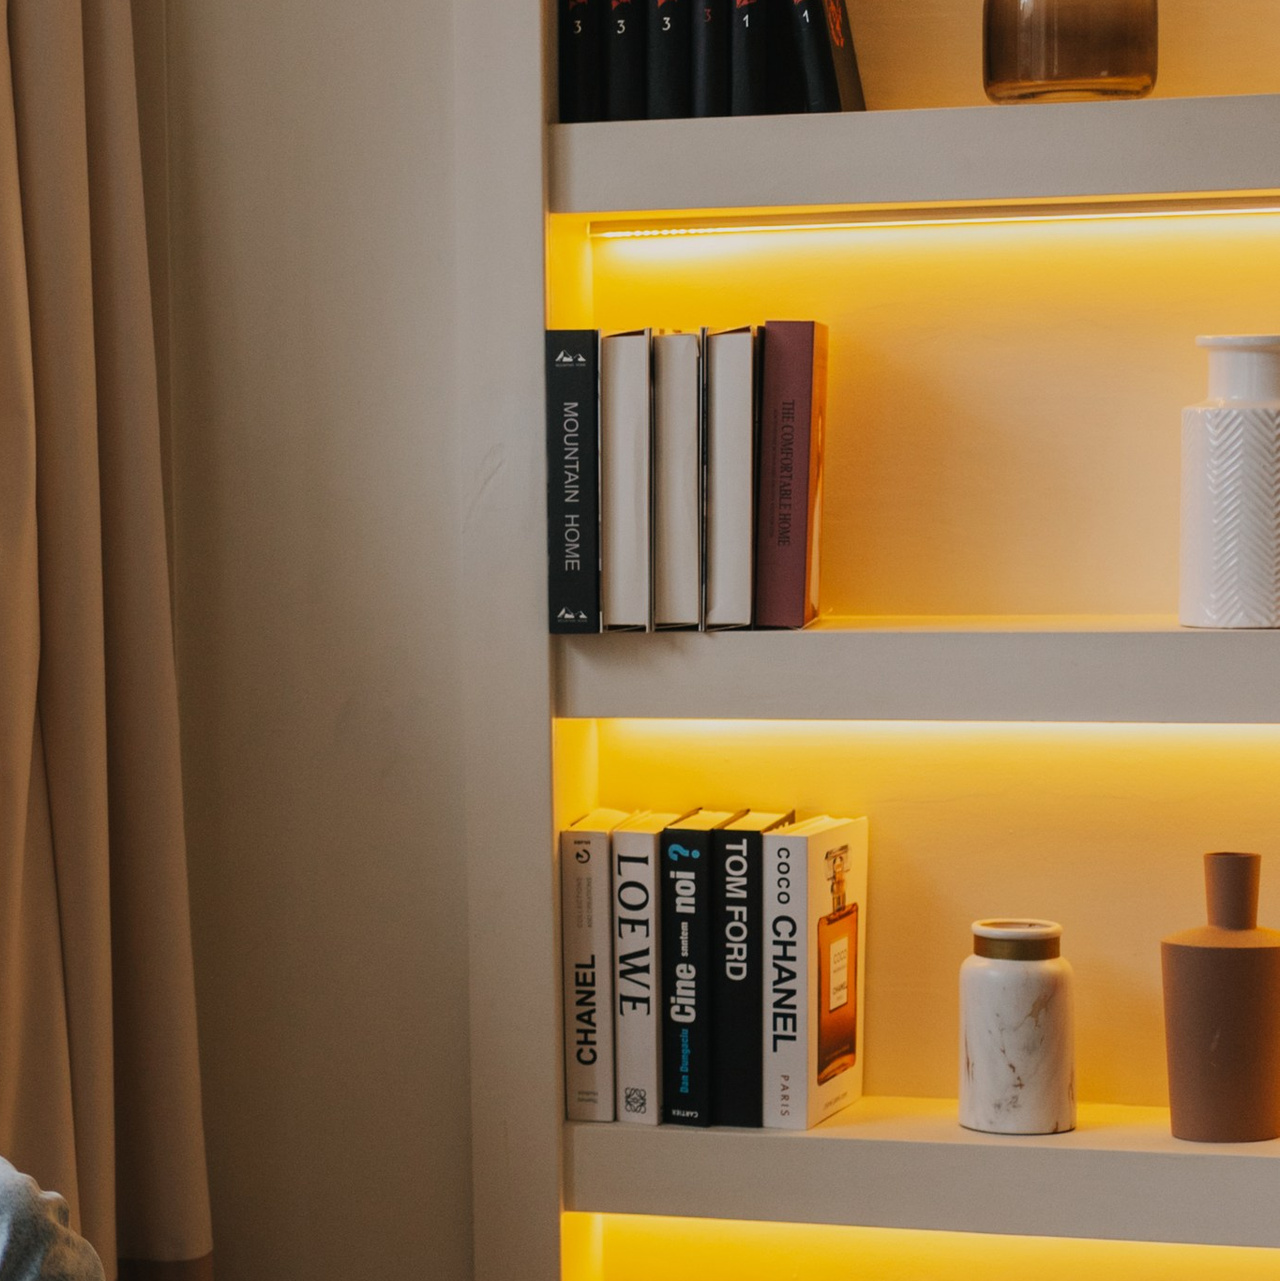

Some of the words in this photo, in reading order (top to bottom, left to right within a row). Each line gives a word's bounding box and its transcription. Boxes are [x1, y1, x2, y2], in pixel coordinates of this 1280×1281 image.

[574, 20, 582, 34] 3
[616, 20, 625, 34] 3
[662, 17, 671, 31] 3
[743, 14, 750, 27] 1
[802, 9, 810, 23] 1
[782, 399, 795, 422] THE
[563, 402, 579, 503] MOUNTAIN
[779, 423, 794, 510] COMFORTABLE
[564, 514, 580, 571] HOME
[777, 513, 792, 547] HOME
[725, 838, 748, 899] TOM
[777, 847, 790, 905] COCO
[670, 870, 696, 914] noi
[617, 854, 651, 1017] LOEWE
[725, 906, 748, 981] FORD
[670, 963, 696, 1023] Cine
[772, 915, 797, 1053] CHANEL
[575, 954, 598, 1066] CHANEL
[680, 1028, 690, 1072] Dungaciu
[680, 1074, 689, 1093] Dan
[780, 1074, 790, 1117] PARIS
